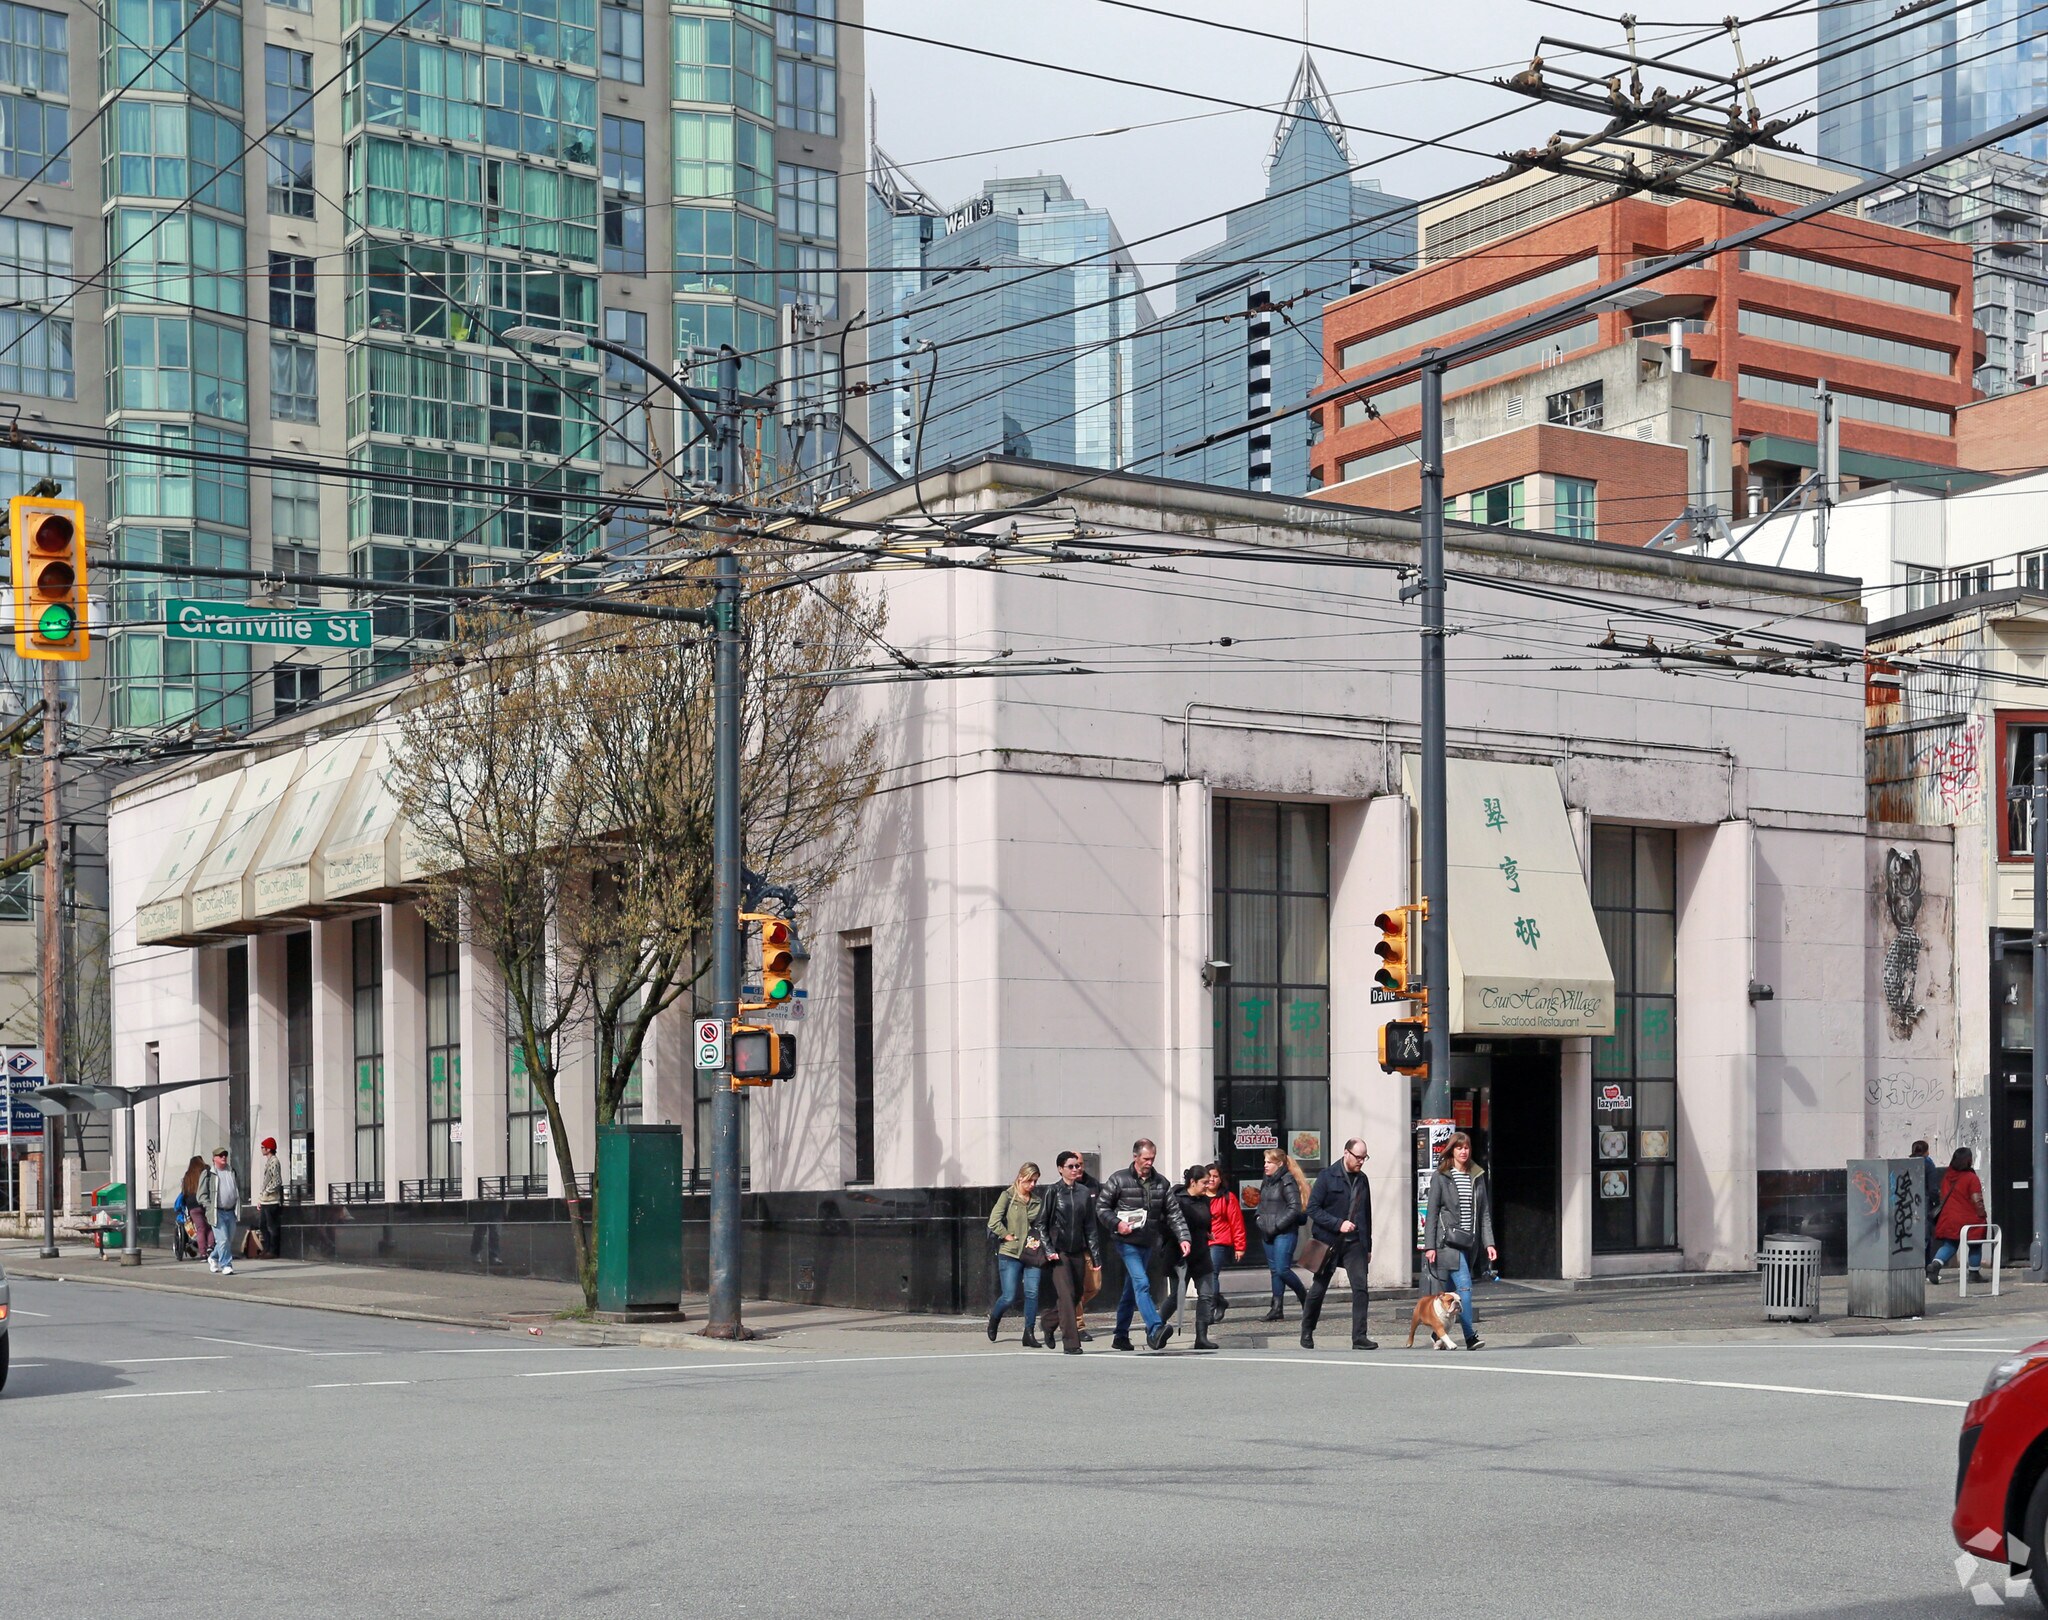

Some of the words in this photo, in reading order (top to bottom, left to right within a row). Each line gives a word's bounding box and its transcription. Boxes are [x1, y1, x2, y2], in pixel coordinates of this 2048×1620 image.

[945, 205, 973, 236] Wall
[179, 606, 312, 639] Granville
[327, 615, 359, 642] St
[1479, 987, 1510, 1009] Tsui
[1509, 987, 1558, 1016] Hang
[1552, 987, 1601, 1017] Village
[767, 1011, 788, 1019] Centre
[1501, 1015, 1536, 1027] Seafood
[1538, 1016, 1579, 1027] Restaurant
[16, 1057, 28, 1070] P
[10, 1079, 41, 1090] onthly
[1236, 1135, 1256, 1144] JUST
